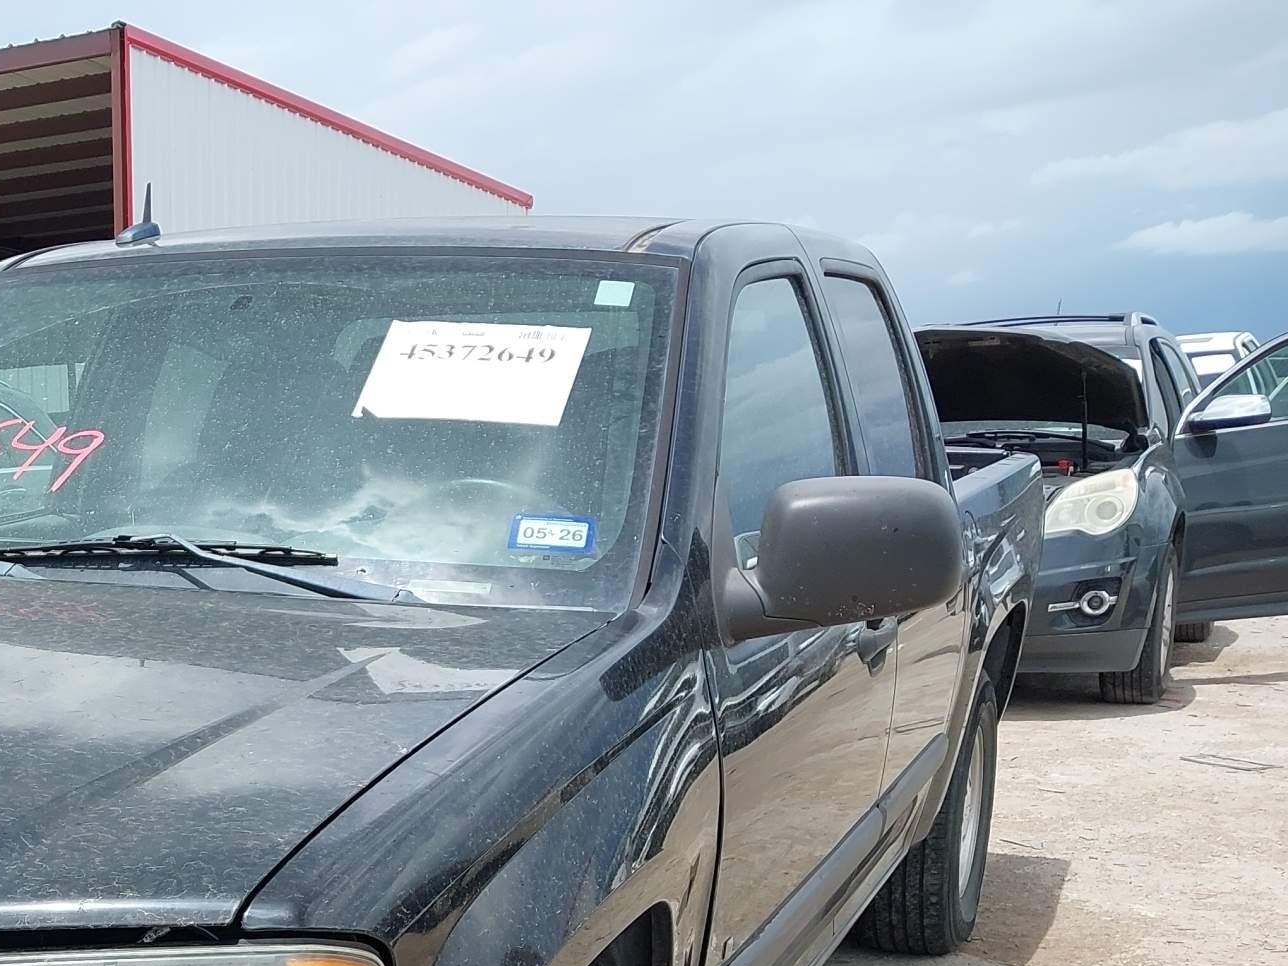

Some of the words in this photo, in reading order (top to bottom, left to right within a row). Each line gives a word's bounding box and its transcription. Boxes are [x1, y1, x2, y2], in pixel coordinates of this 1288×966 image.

[399, 343, 556, 363] 45372649
[522, 526, 548, 540] 05
[558, 528, 585, 542] 26
